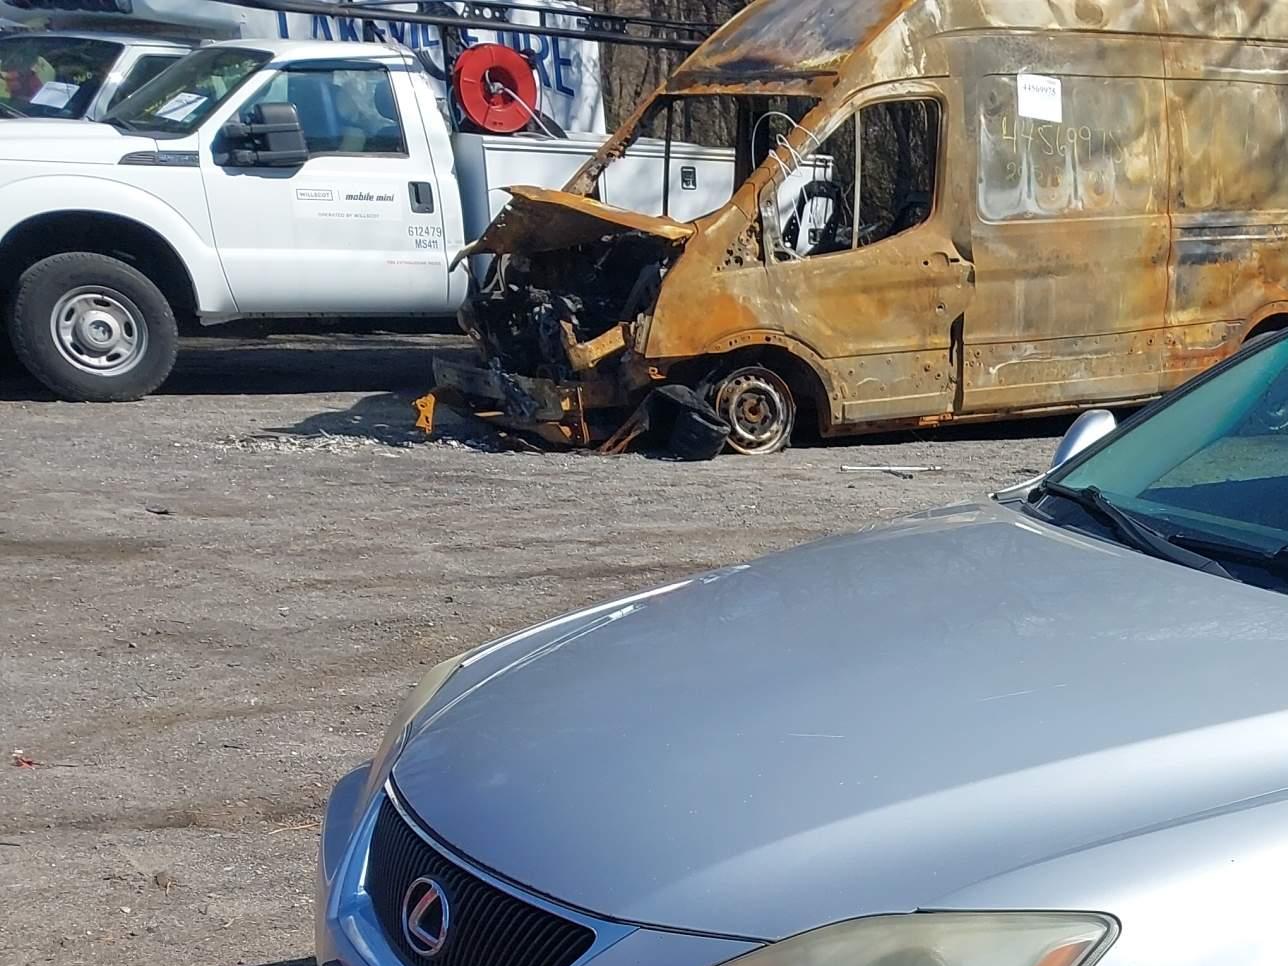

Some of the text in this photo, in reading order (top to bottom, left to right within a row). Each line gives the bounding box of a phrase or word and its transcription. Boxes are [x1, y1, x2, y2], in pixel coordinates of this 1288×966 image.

[345, 191, 374, 201] mobile
[376, 193, 395, 202] mini
[408, 226, 442, 238] 612479
[415, 239, 439, 249] MS411
